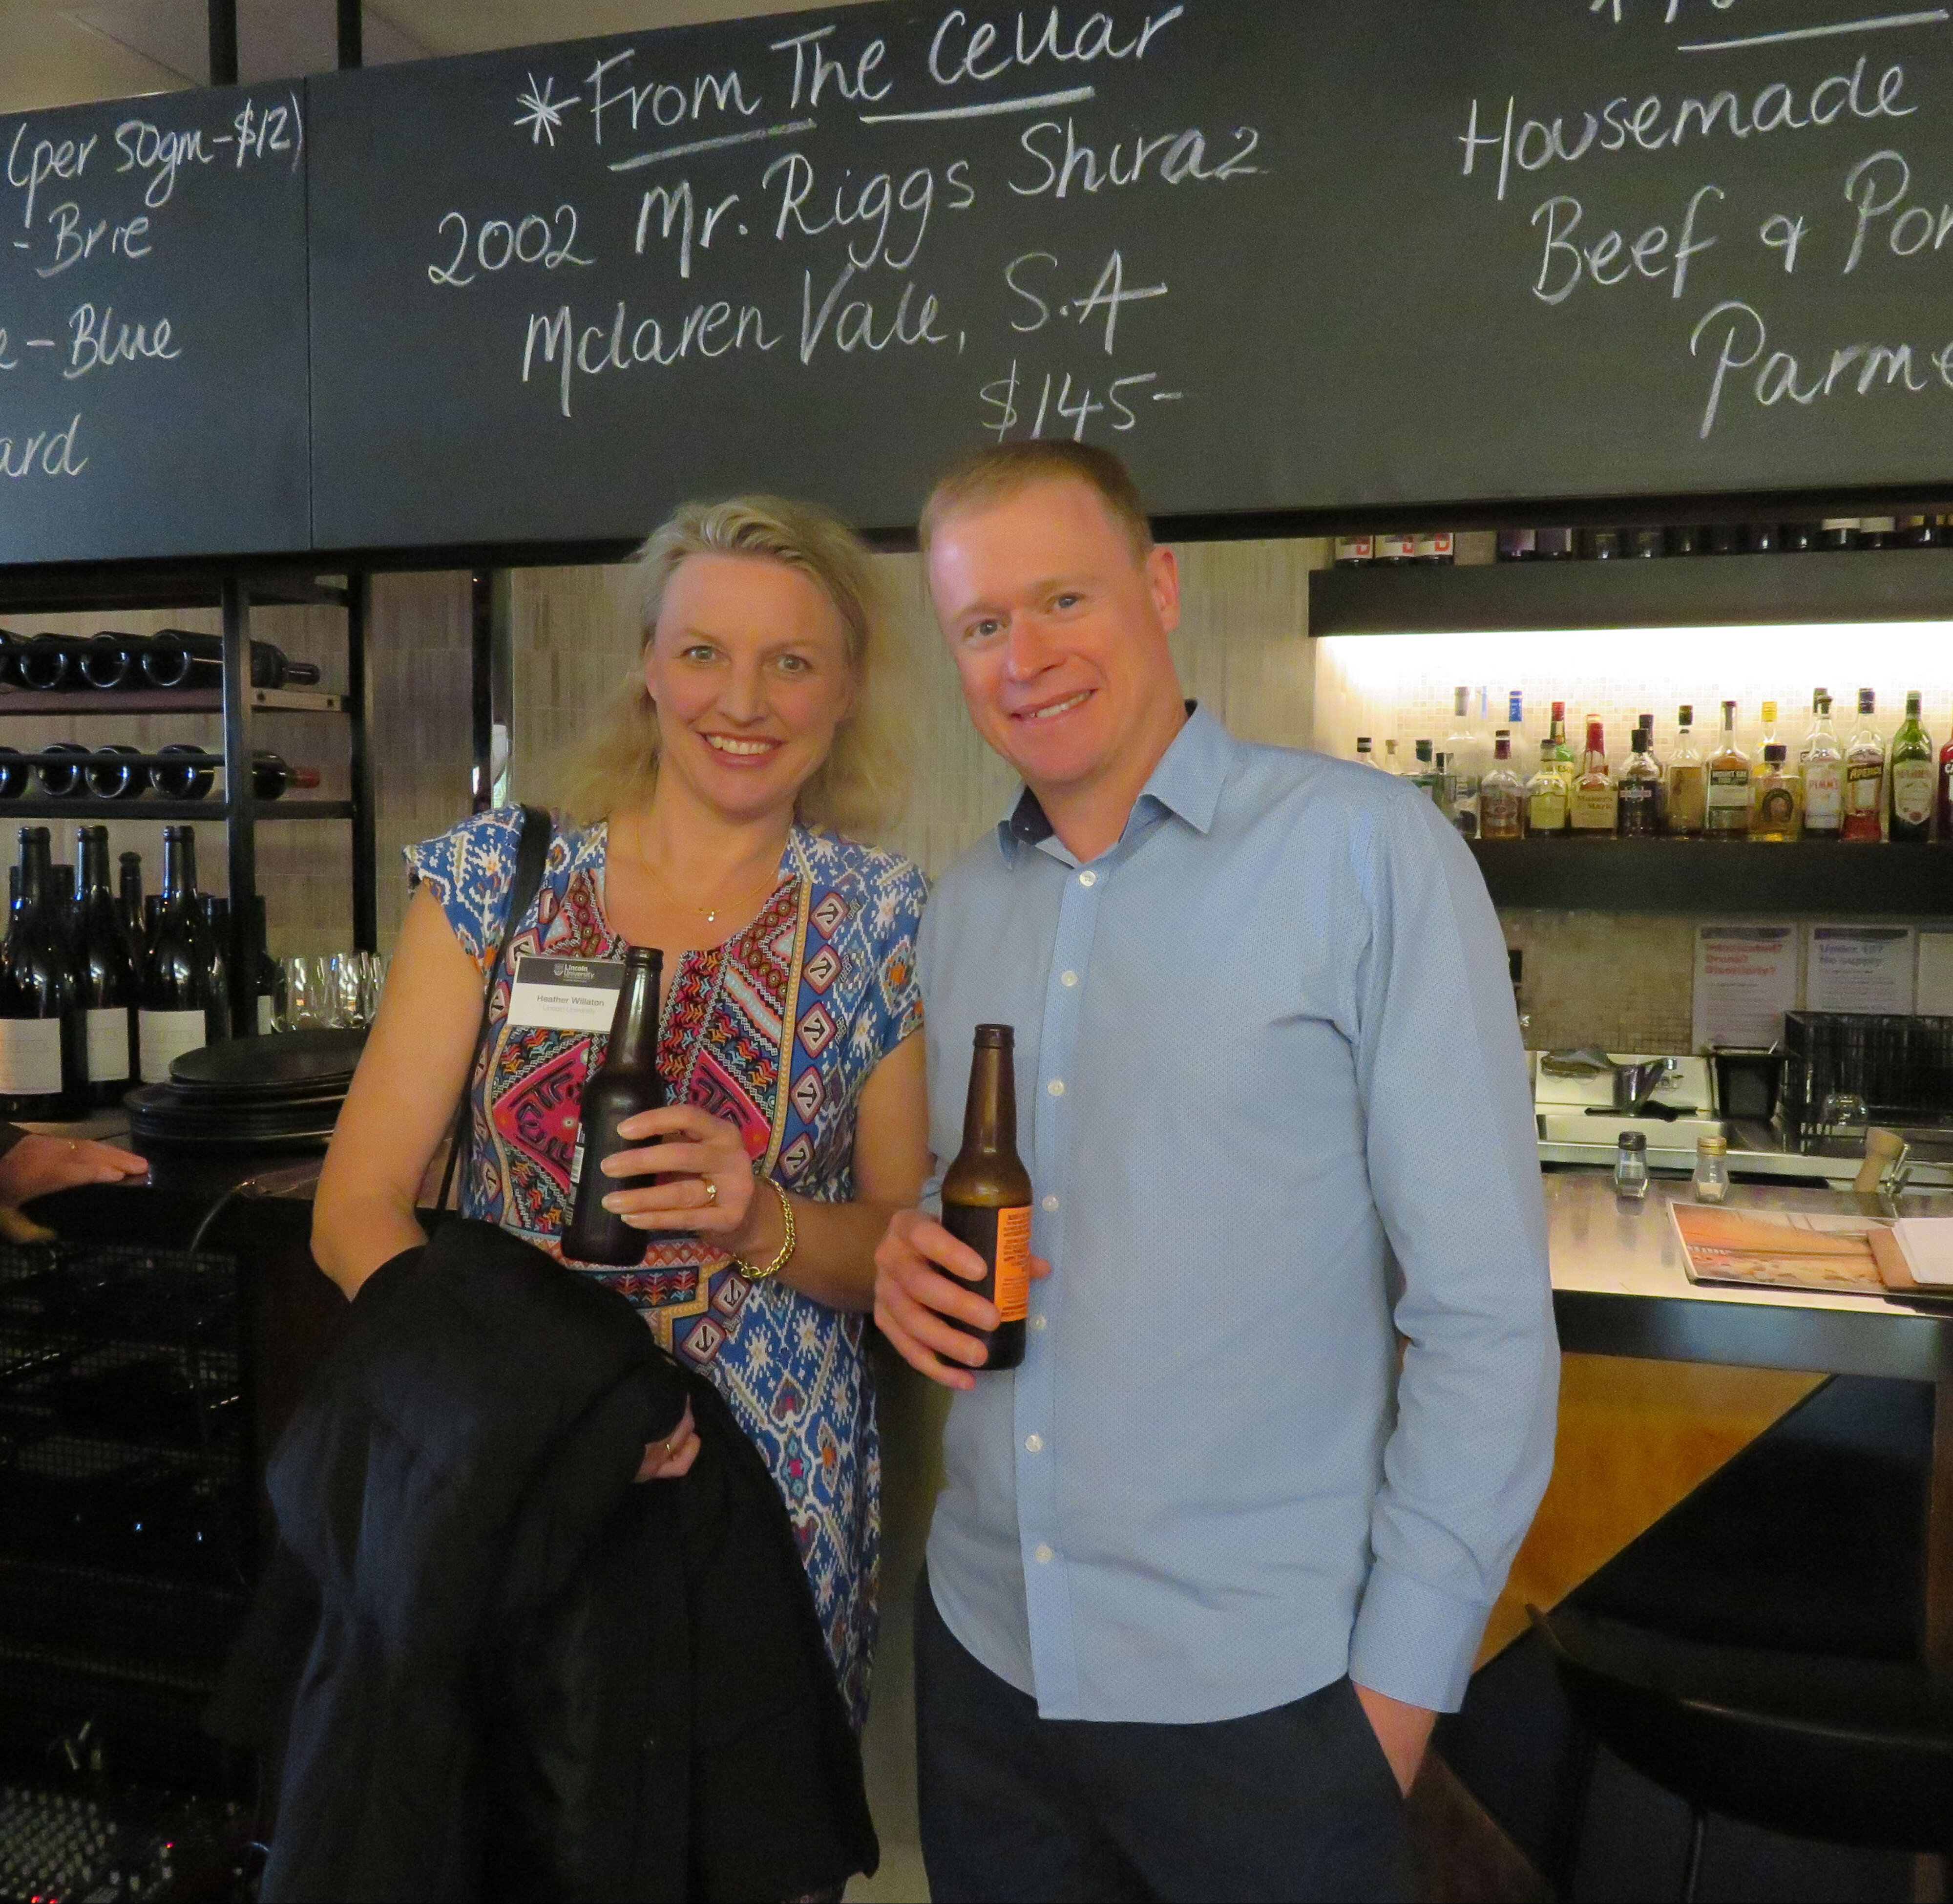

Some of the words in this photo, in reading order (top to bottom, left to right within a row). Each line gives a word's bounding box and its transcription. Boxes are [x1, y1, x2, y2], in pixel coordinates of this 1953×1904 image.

[586, 48, 762, 145] From
[770, 25, 892, 109] The
[928, 5, 1184, 85] Cellar
[1458, 55, 1918, 201] Housemade
[7, 122, 98, 229] (per
[428, 204, 597, 286] 2002
[635, 179, 749, 278] Mr.
[762, 152, 975, 270] Riggs
[1008, 116, 1268, 198] Shiraz
[1531, 184, 1725, 305] Beef
[799, 261, 966, 366] Vale,
[1005, 248, 1168, 355] S.A
[537, 994, 569, 1004] Heather
